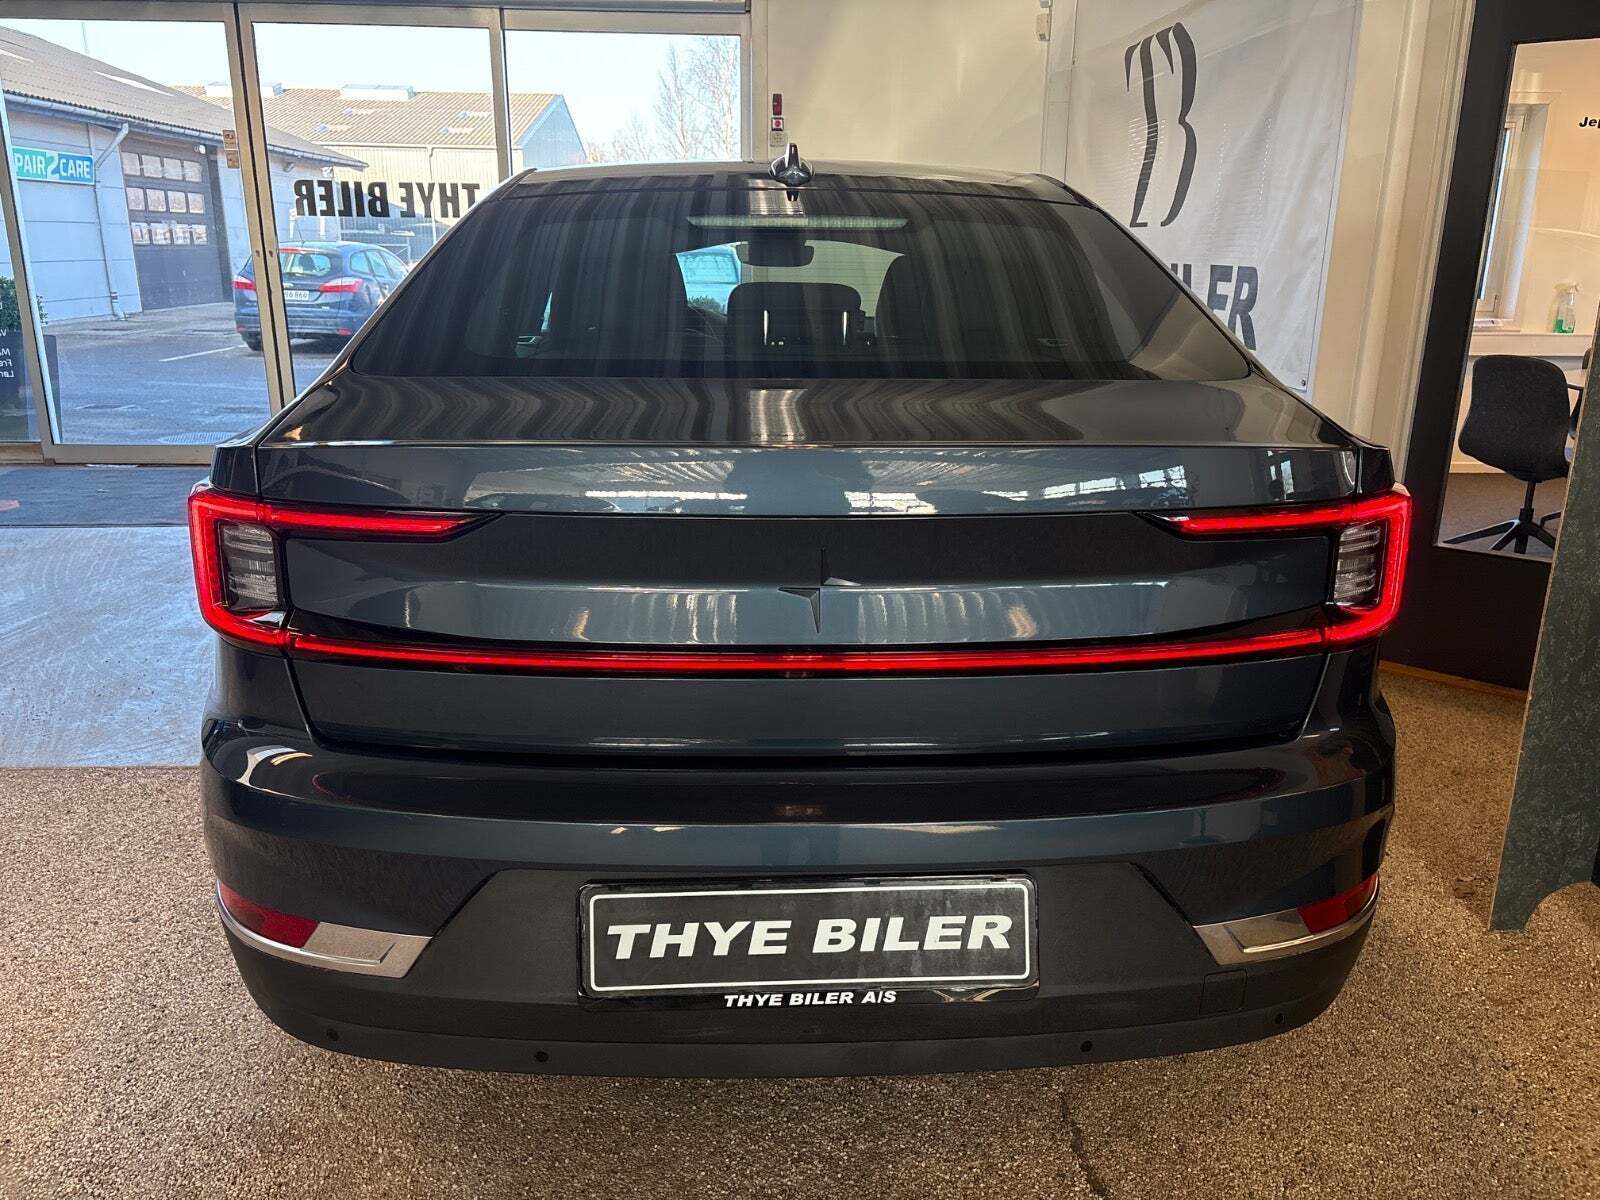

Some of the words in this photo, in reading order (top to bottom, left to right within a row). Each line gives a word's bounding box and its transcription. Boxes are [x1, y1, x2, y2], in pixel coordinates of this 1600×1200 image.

[607, 921, 792, 960] THYE
[812, 915, 1013, 953] BILER
[724, 994, 783, 1008] THYE
[788, 992, 853, 1006] BILER
[860, 990, 897, 1004] A/S
